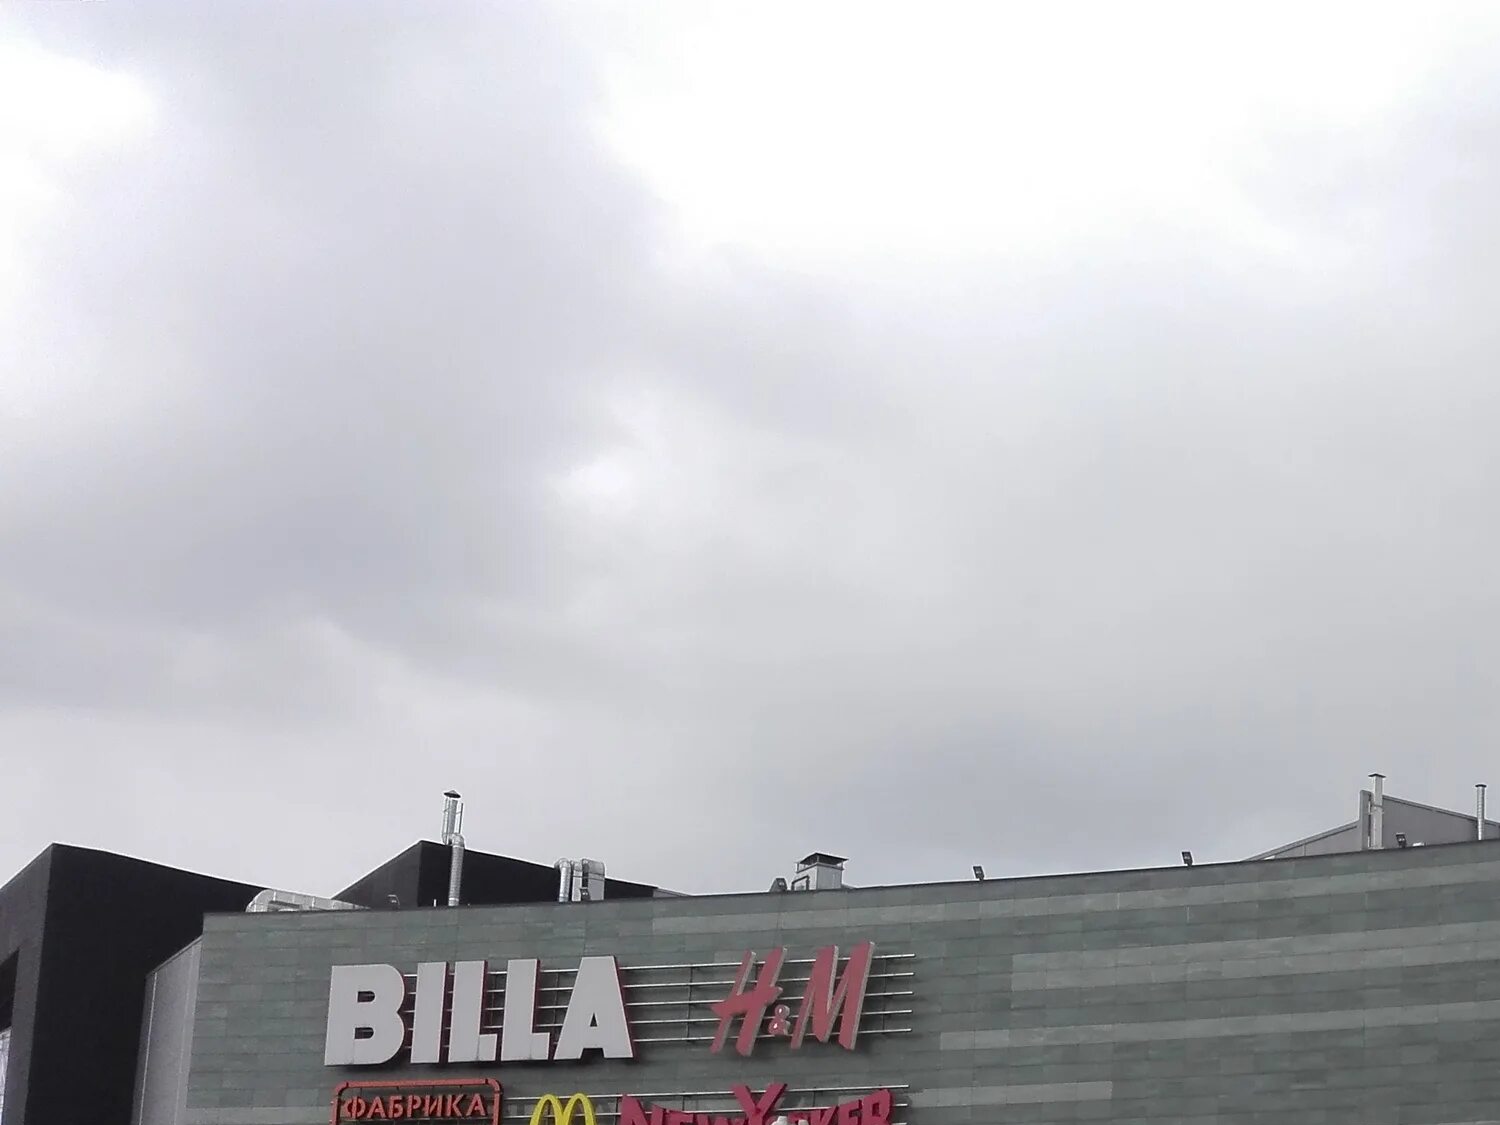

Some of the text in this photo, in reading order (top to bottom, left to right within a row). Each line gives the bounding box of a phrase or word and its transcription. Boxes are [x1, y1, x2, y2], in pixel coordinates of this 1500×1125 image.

[324, 955, 634, 1066] BILLA
[711, 940, 876, 1057] H&M
[343, 1093, 488, 1119] ФАБРИКА
